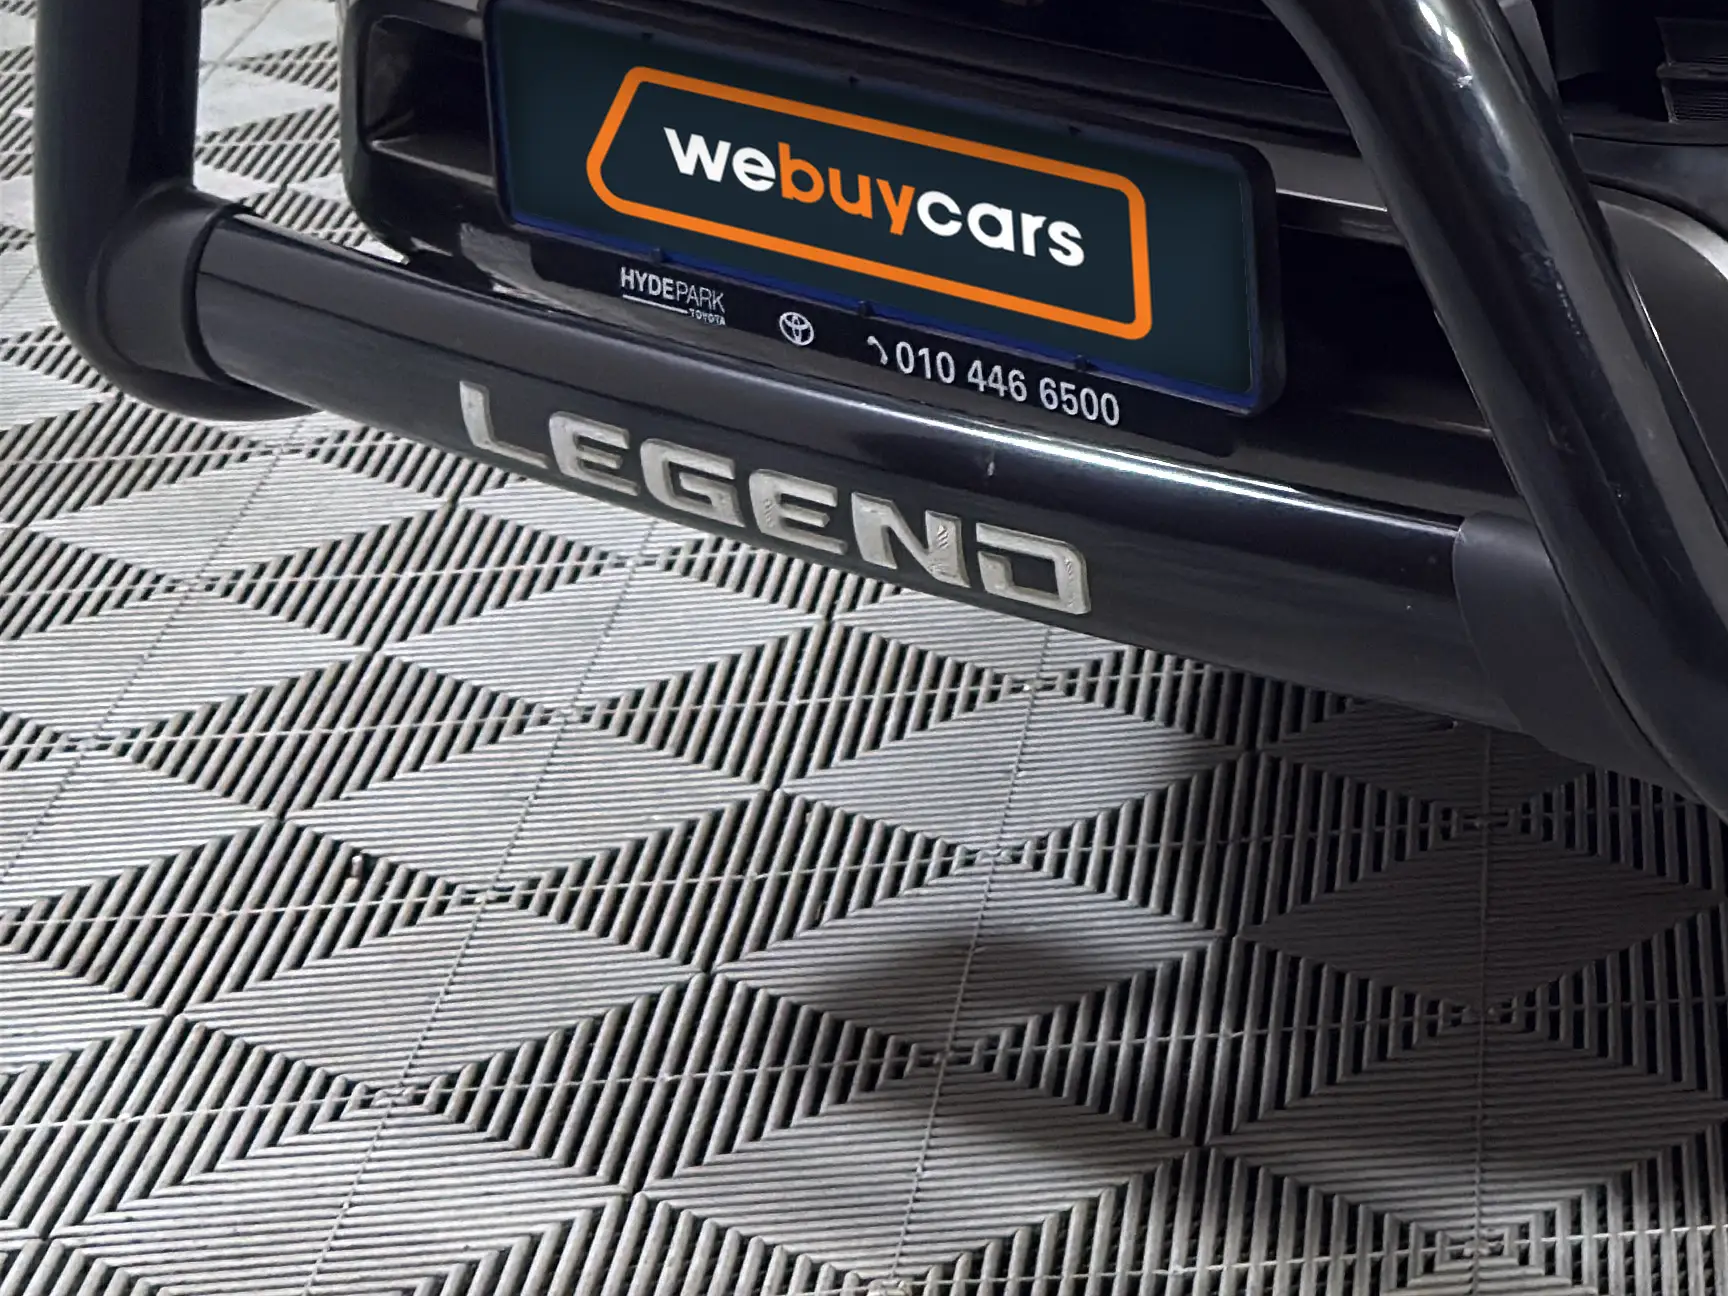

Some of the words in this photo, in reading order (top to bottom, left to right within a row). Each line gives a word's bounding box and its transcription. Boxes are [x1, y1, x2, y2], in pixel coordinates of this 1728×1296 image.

[688, 307, 727, 326] TOYOTA
[896, 340, 956, 385] 010
[966, 358, 1029, 403] 446
[1039, 376, 1121, 427] 6500
[459, 380, 1093, 615] LEGEND
